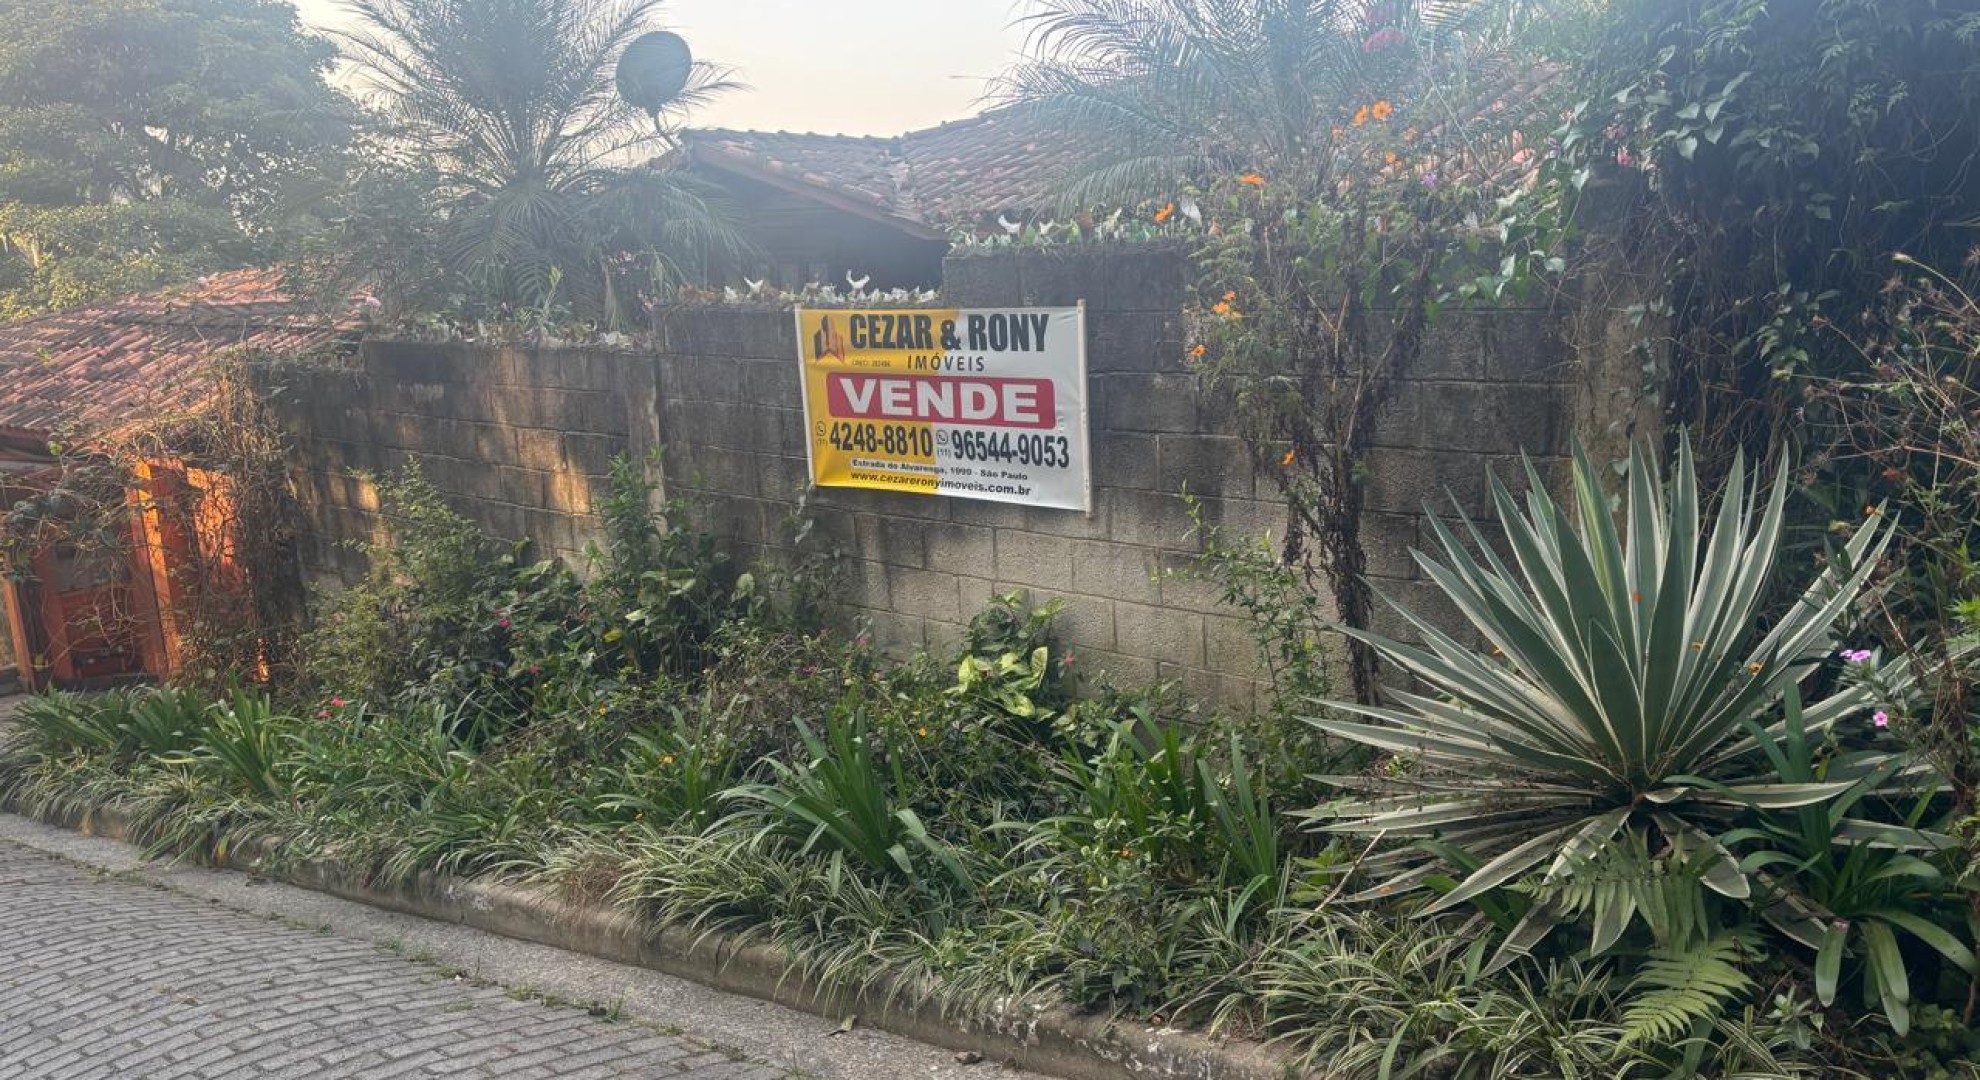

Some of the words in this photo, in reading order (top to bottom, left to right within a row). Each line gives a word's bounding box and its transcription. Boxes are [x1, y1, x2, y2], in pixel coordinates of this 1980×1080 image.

[850, 313, 933, 349] CEZAR
[940, 319, 962, 350] &
[967, 313, 1049, 352] RONY
[907, 352, 985, 372] IMÓVEIS
[839, 378, 1041, 424] VENDE
[830, 421, 933, 457] 4248-8810
[951, 429, 1070, 469] 96544-9053
[850, 471, 1032, 496] www.cezareronyimoveis.com.br
[1001, 471, 1028, 481] Paulo
